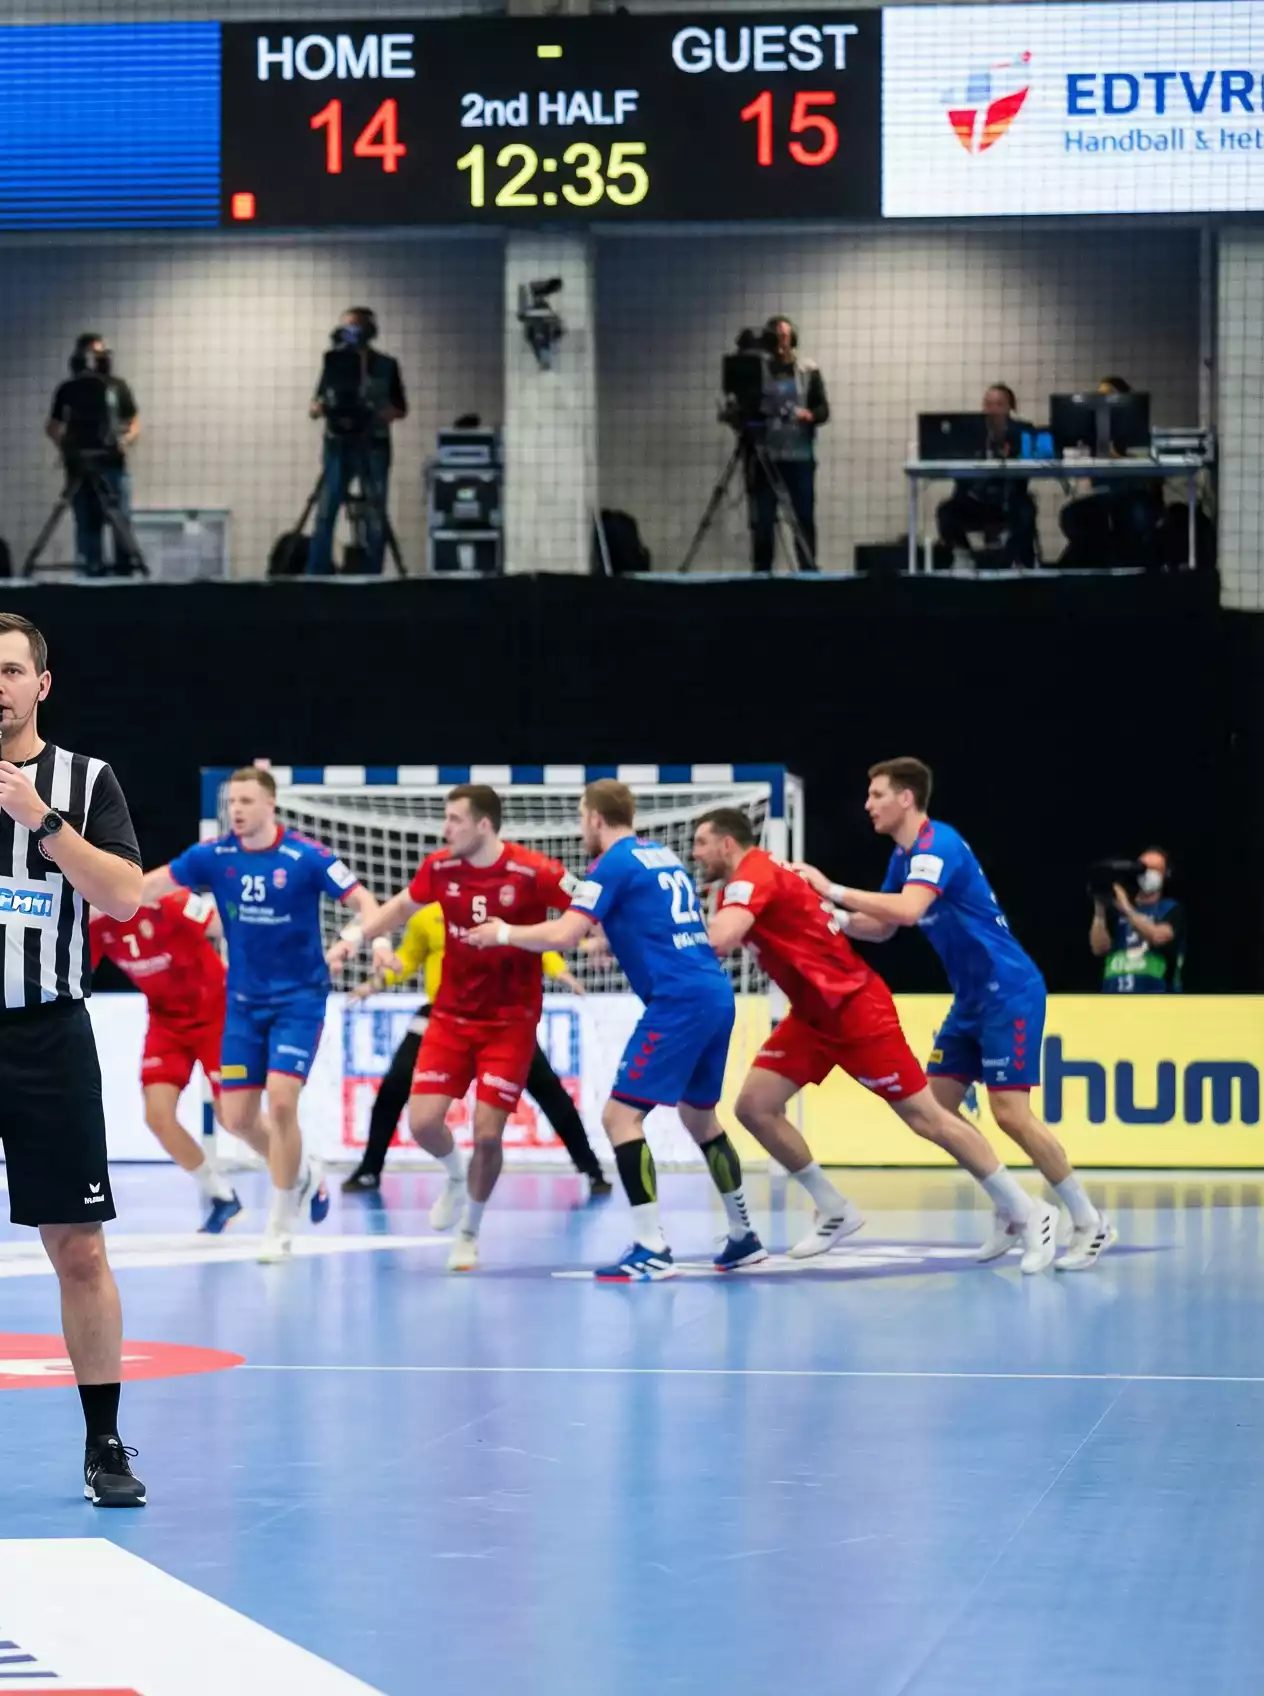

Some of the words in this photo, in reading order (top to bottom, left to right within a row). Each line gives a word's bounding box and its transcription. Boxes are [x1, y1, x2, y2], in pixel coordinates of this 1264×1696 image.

[256, 33, 416, 81] HOME
[671, 24, 859, 74] GUEST
[460, 91, 529, 128] 2nd
[537, 90, 639, 126] HALF
[1066, 69, 1264, 116] EDTVR
[309, 97, 407, 174] 14
[740, 89, 840, 167] 15
[1064, 127, 1184, 152] Handball
[1194, 129, 1210, 151] &
[456, 141, 650, 208] 12:35
[240, 873, 267, 903] 25
[471, 894, 488, 924] 5
[657, 869, 701, 925] 22
[1042, 1033, 1261, 1126] hum
